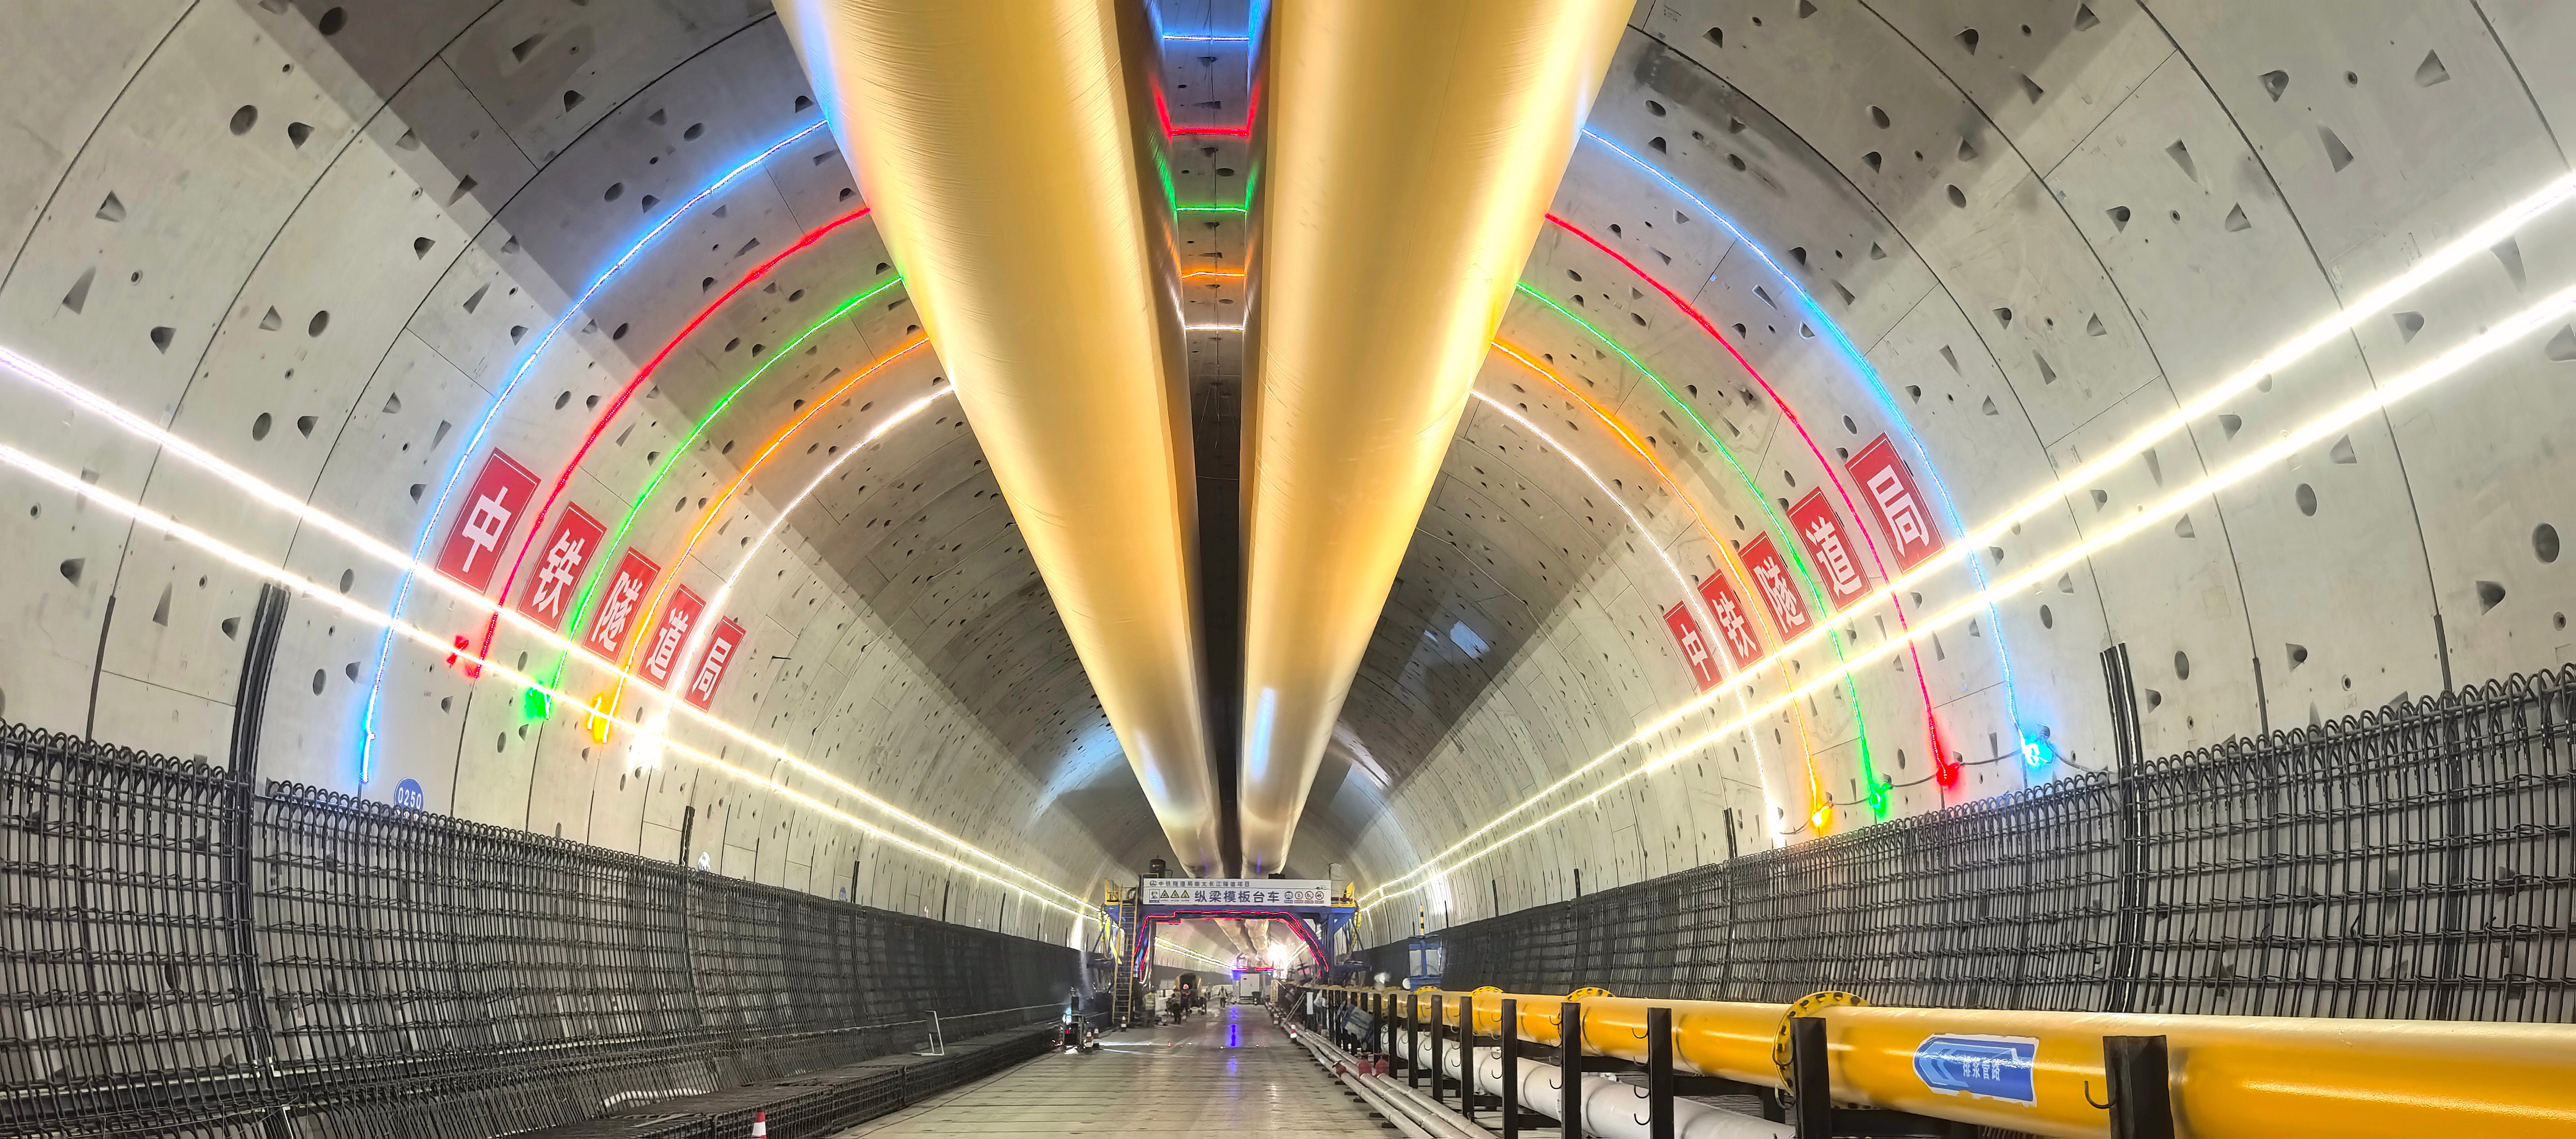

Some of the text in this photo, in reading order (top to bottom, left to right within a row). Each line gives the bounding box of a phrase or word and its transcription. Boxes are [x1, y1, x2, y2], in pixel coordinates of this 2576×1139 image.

[398, 787, 422, 810] 0250
[1194, 890, 1280, 903] 纵梁模板台车
